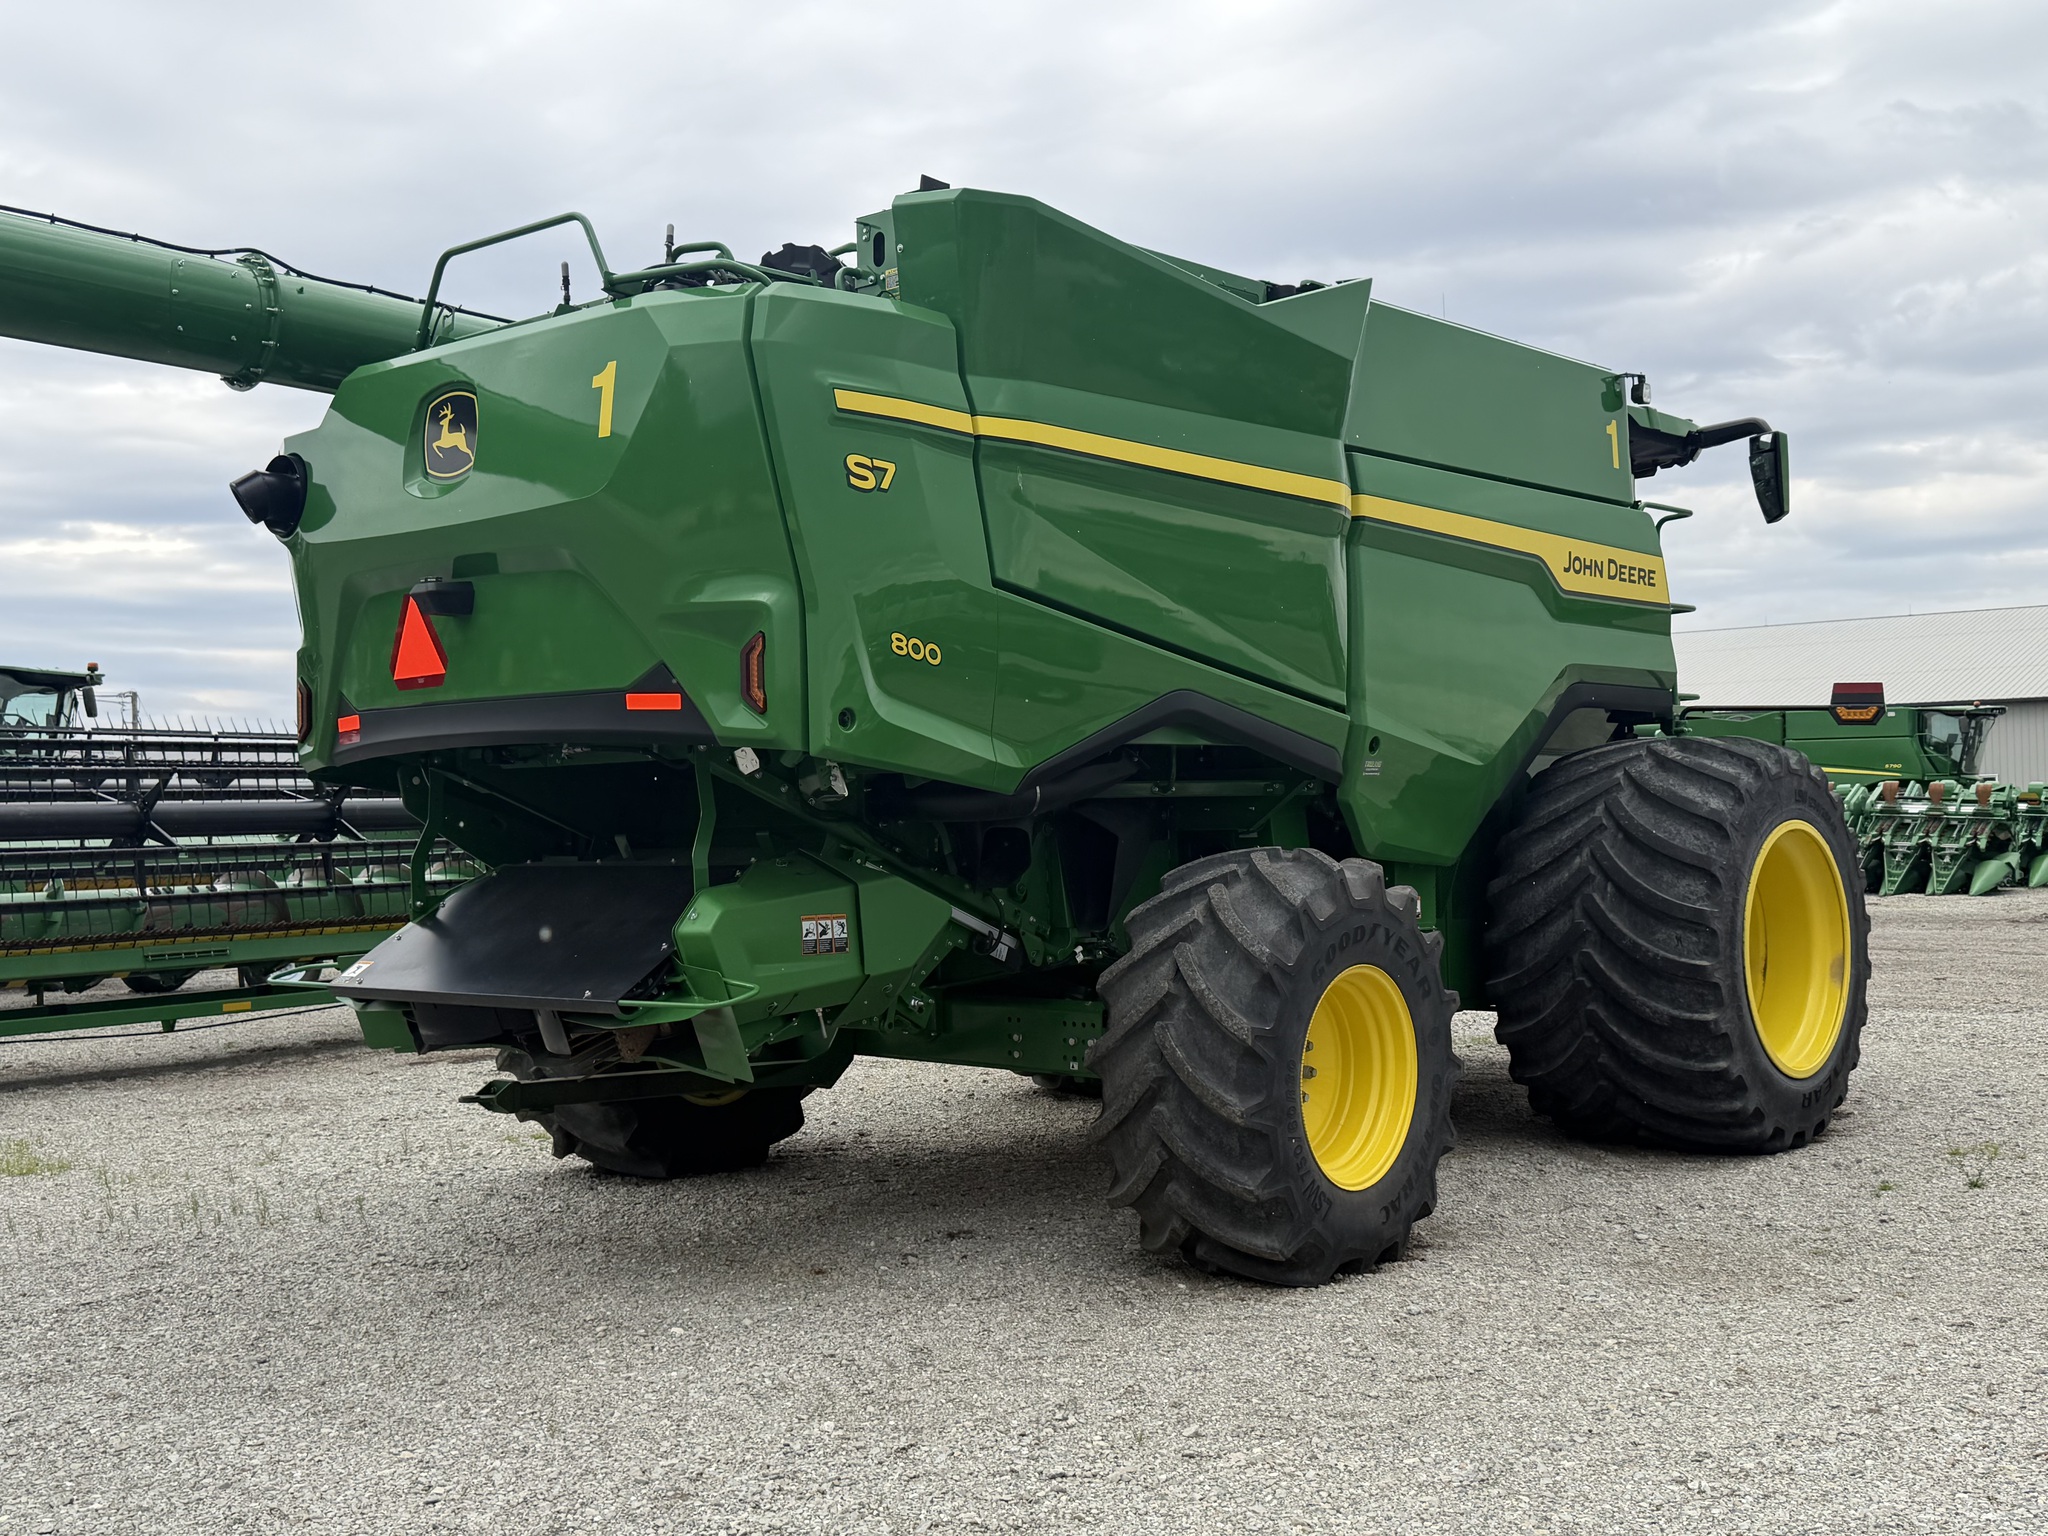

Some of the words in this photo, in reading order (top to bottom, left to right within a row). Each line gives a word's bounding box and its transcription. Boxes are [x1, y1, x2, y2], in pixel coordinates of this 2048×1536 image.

[592, 360, 617, 438] 1
[1606, 419, 1620, 469] 1
[845, 453, 897, 493] S7
[1563, 551, 1604, 578] JOHN
[1607, 558, 1656, 587] DEERE
[890, 632, 942, 666] 800
[1311, 922, 1432, 999] GOODYEAR
